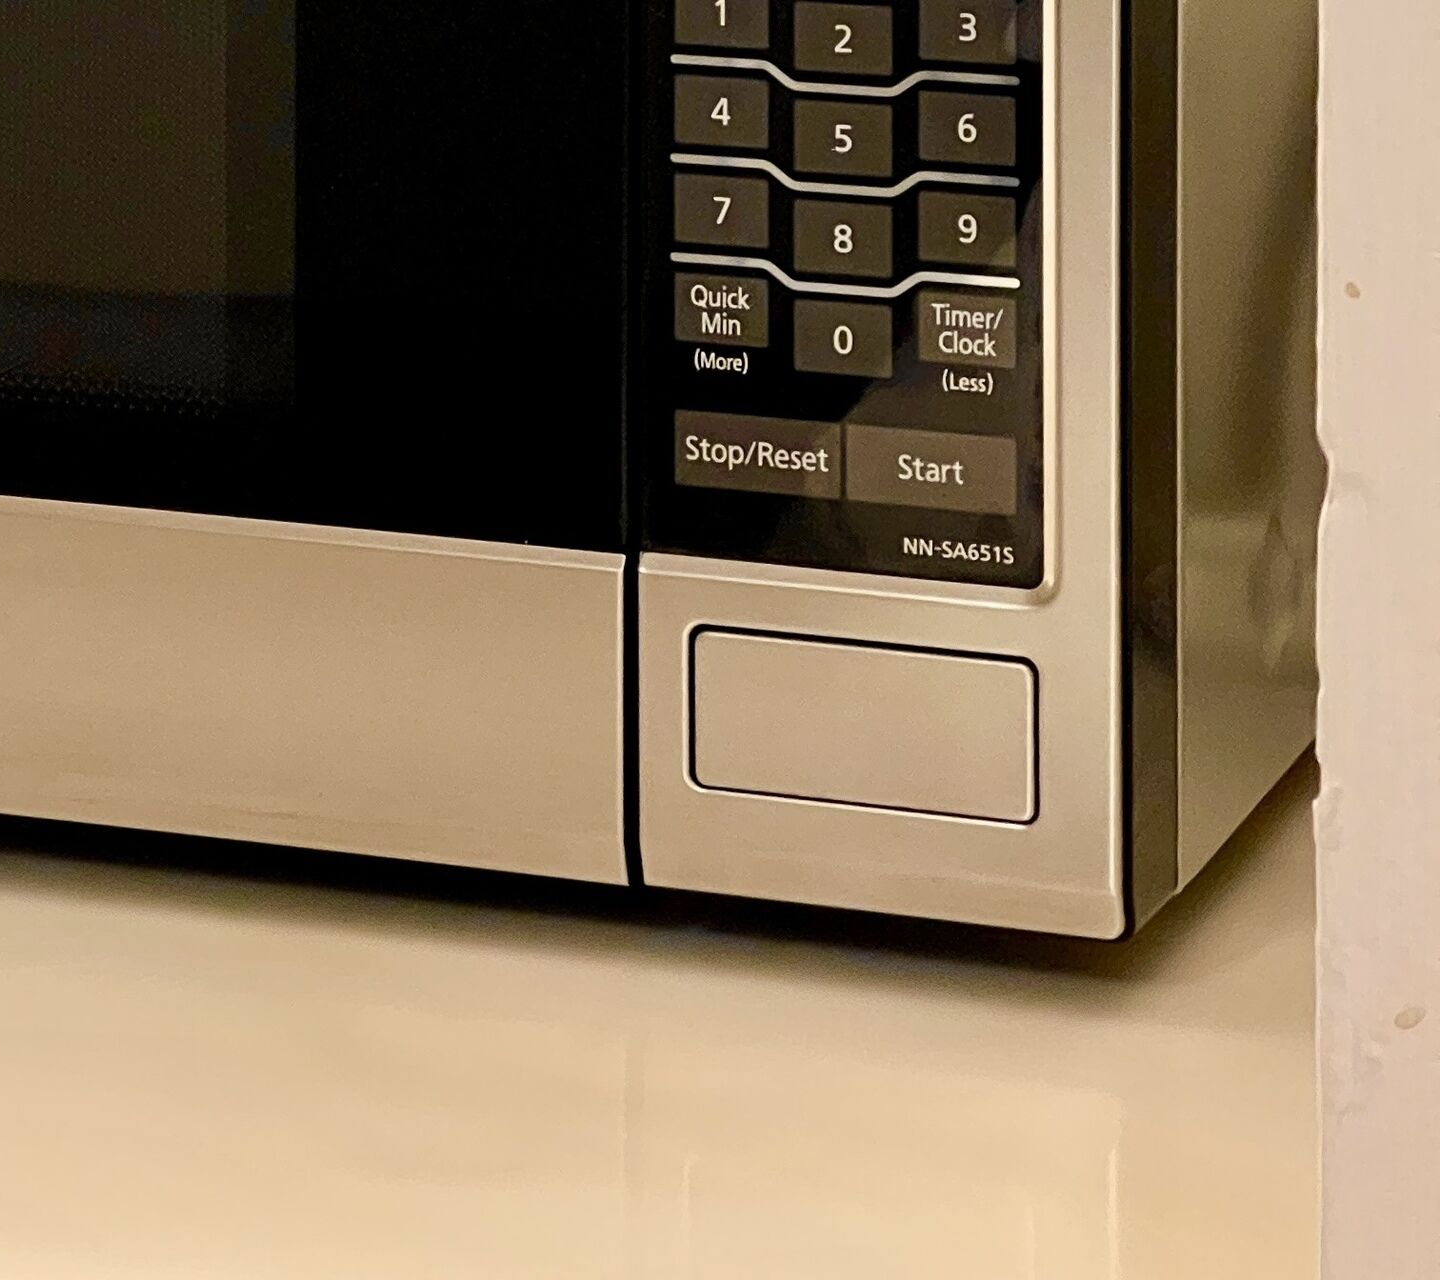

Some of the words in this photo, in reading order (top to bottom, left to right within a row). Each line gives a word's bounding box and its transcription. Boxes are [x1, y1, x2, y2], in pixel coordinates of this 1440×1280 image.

[833, 23, 853, 54] 2
[957, 11, 978, 42] 3
[710, 96, 731, 126] 4
[833, 123, 853, 153] 5
[957, 112, 978, 143] 6
[712, 196, 732, 226] 7
[832, 223, 854, 254] 8
[957, 213, 978, 244] 9
[690, 283, 751, 312] Quick
[701, 312, 742, 337] Min
[931, 302, 1004, 331] Timer/
[832, 325, 854, 355] 0
[937, 331, 997, 358] Clock
[693, 347, 750, 375] (More)
[941, 368, 995, 396] (Less)
[684, 434, 830, 473] Stop/Reset
[897, 453, 965, 486] Start
[902, 536, 1015, 565] NN-SA651S
